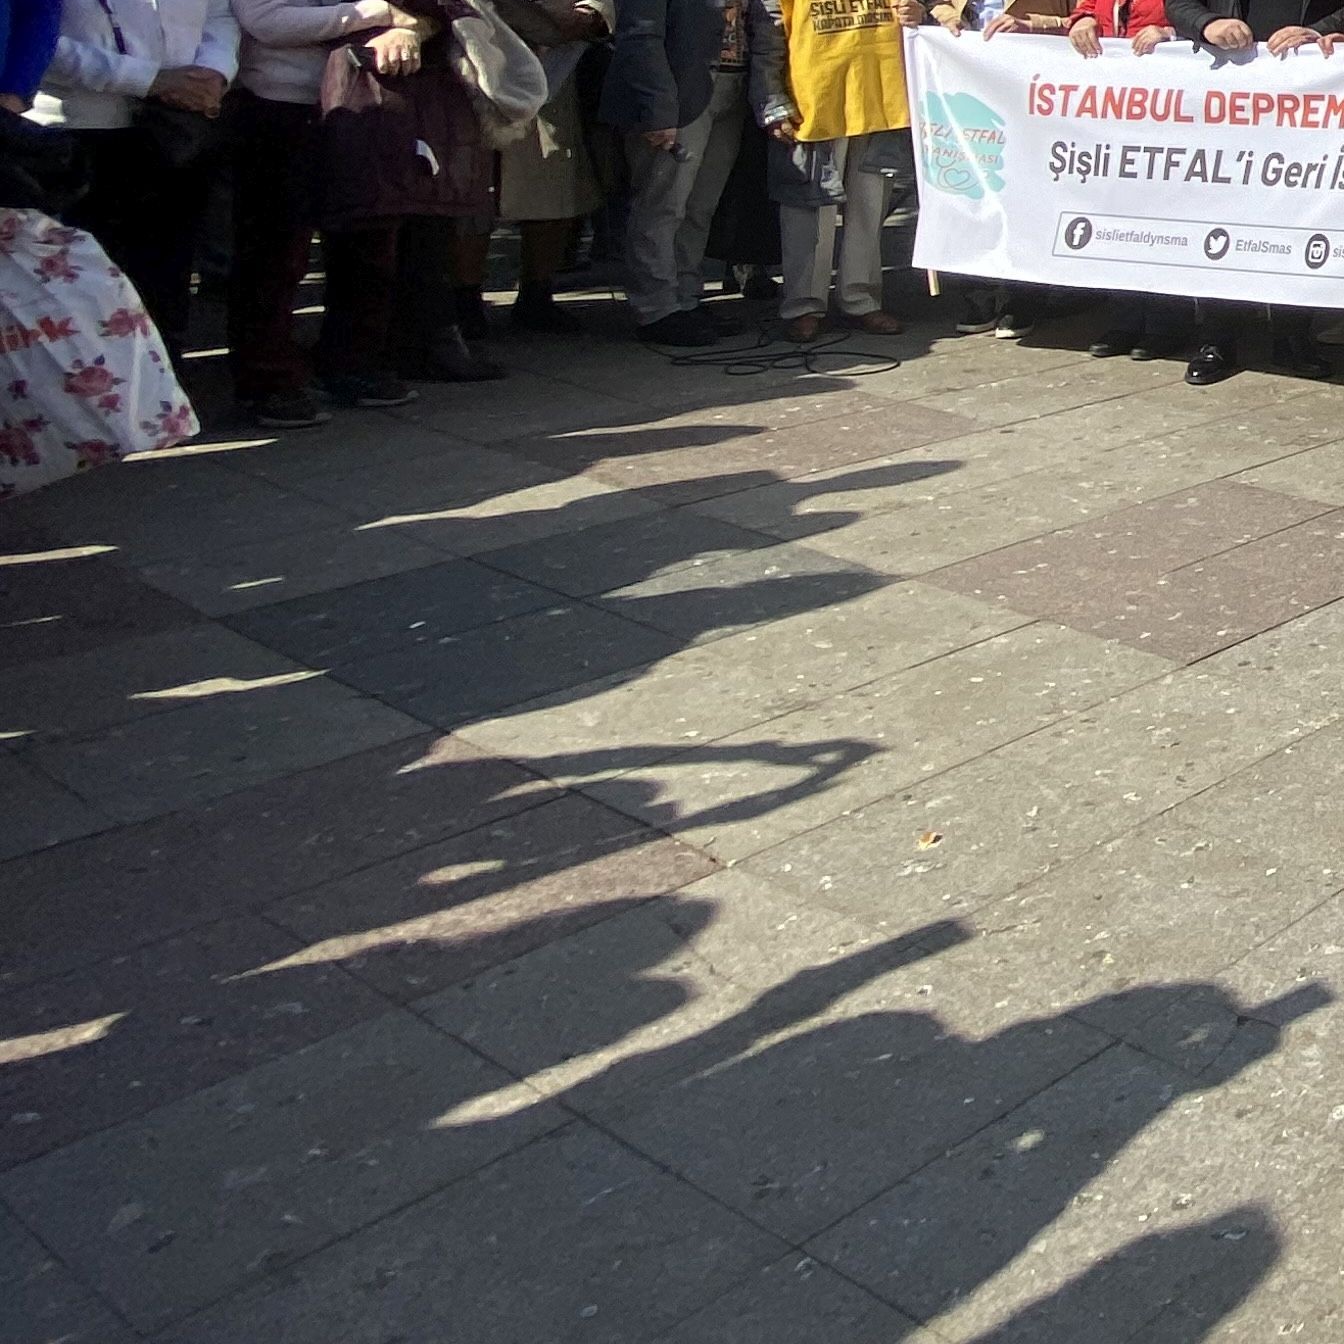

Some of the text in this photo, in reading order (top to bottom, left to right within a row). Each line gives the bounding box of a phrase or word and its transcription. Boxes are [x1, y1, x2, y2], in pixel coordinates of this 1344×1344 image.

[1028, 73, 1195, 123] İSTANBUL
[1049, 141, 1111, 184] Şişli
[1119, 146, 1254, 184] ETFAL'i
[1260, 152, 1328, 190] Geri
[1095, 228, 1188, 247] sislietfaldynsma
[1235, 239, 1292, 255] EtfalSmas
